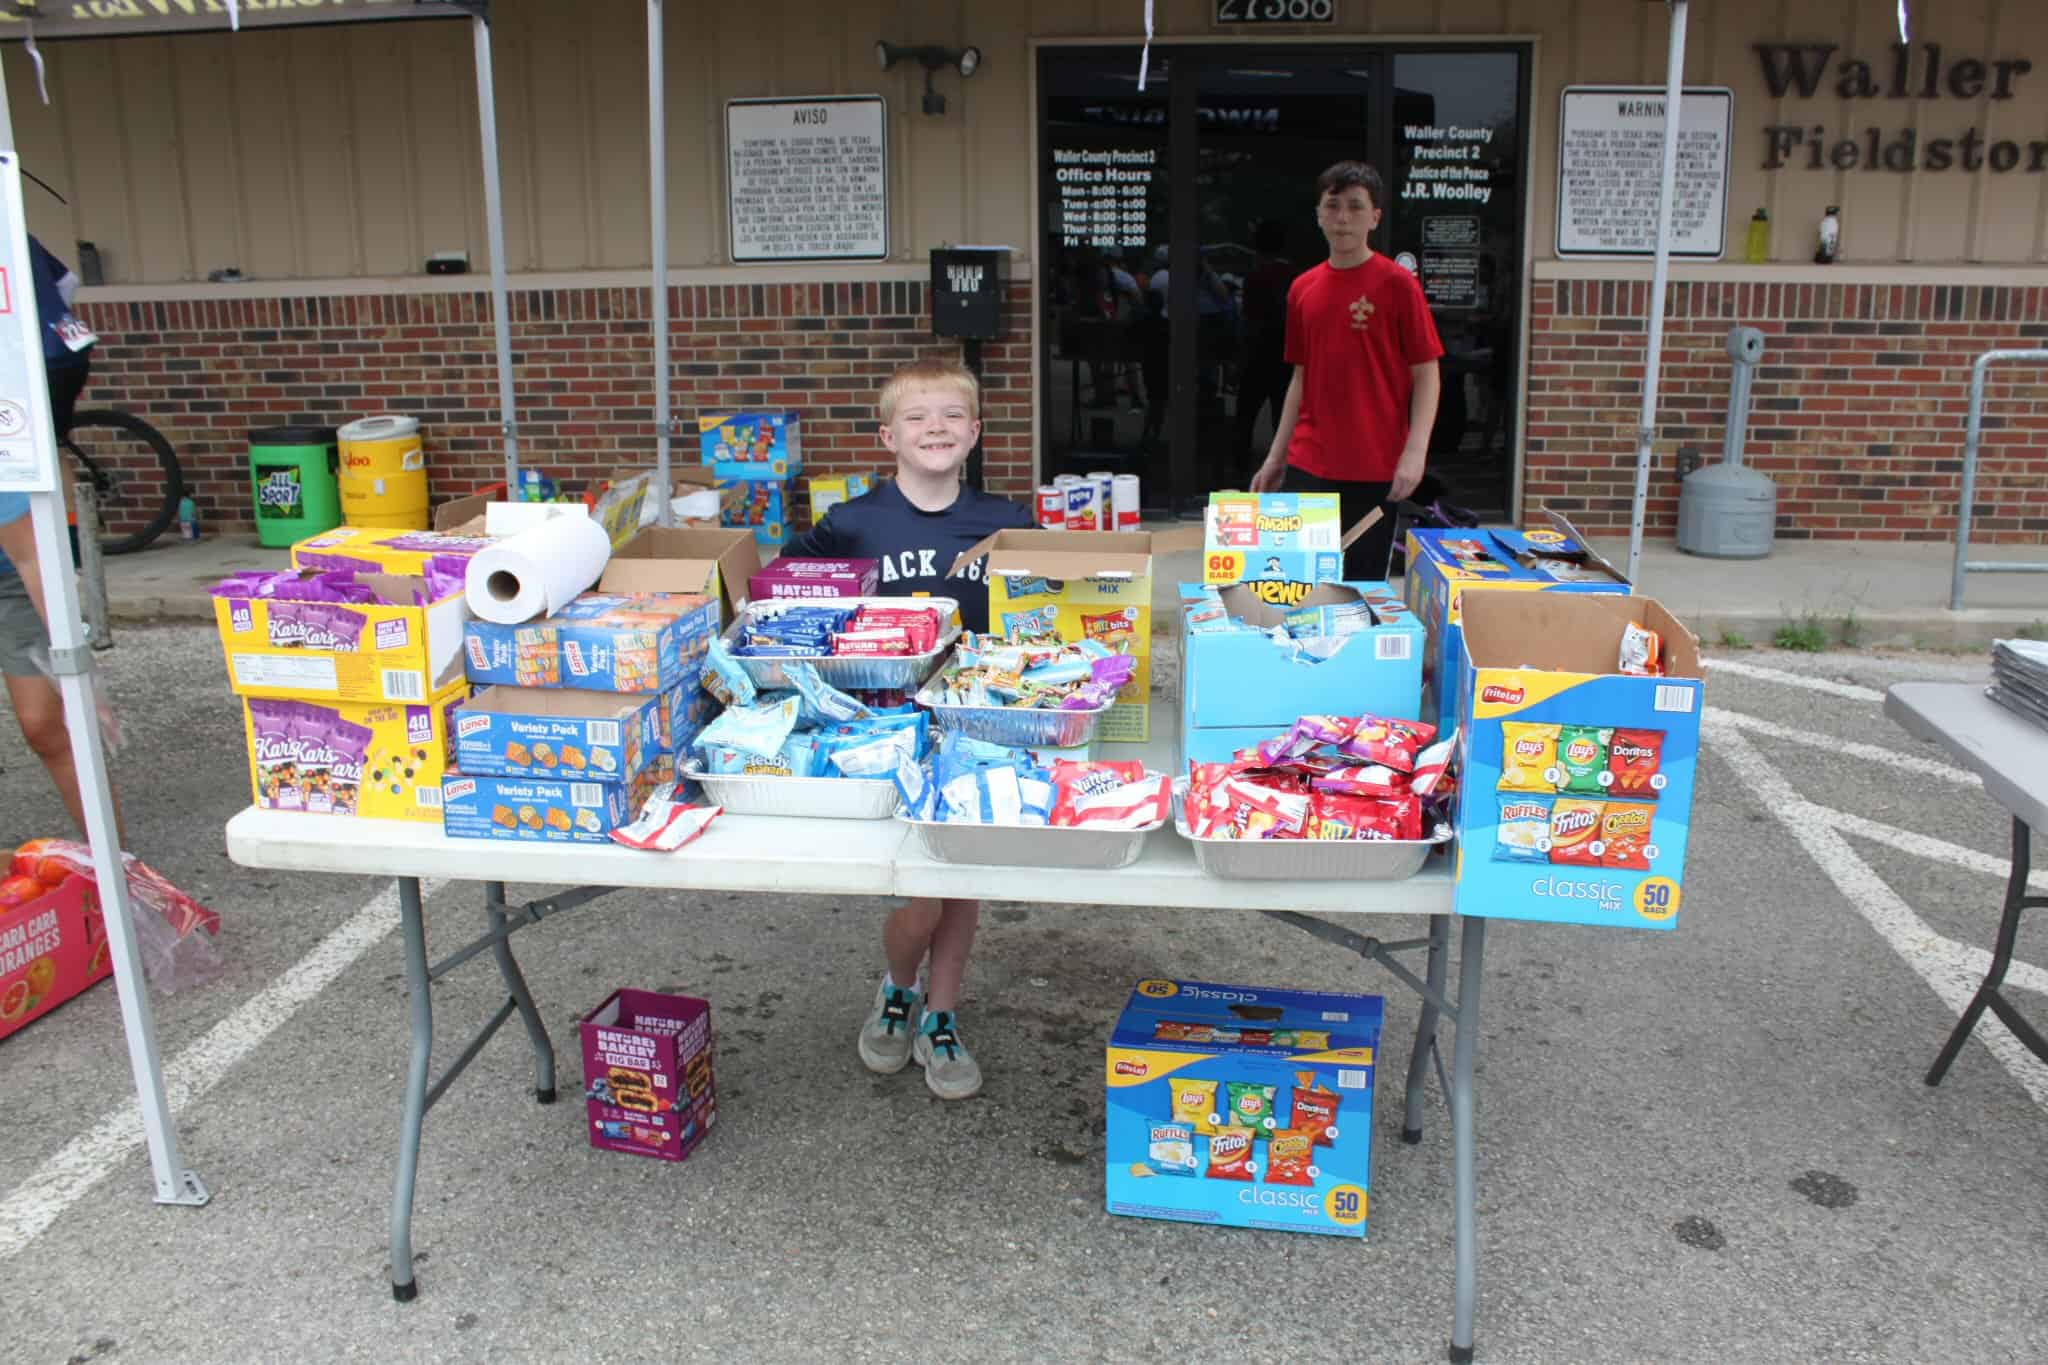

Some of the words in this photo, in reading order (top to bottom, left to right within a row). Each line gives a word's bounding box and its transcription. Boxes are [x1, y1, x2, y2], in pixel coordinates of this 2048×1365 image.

[1752, 41, 2033, 100] Waller
[1617, 101, 1666, 117] WARNIN
[793, 109, 828, 125] AVISO
[1404, 125, 1444, 140] Waller
[1448, 125, 1493, 143] County
[1054, 150, 1081, 163] Waller
[1082, 150, 1111, 165] County
[1112, 149, 1148, 163] Precinct
[1414, 146, 1467, 160] Precinct
[1472, 146, 1480, 160] 2
[1056, 168, 1104, 181] Office
[1105, 168, 1152, 181] Hours
[1409, 165, 1438, 179] Justice
[1463, 166, 1489, 179] Peace
[1062, 185, 1085, 196] Mon
[1401, 182, 1430, 199] J.R.
[1432, 182, 1491, 204] Woolley
[1063, 212, 1087, 222] Wed
[1064, 236, 1079, 247] Fri
[271, 473, 289, 487] ALL
[261, 486, 300, 505] SPORT
[1209, 556, 1235, 570] 60
[1209, 571, 1235, 579] BARS
[1098, 585, 1119, 593] MIX
[232, 609, 250, 621] 40
[409, 714, 429, 731] 40
[459, 716, 489, 732] Lance
[511, 721, 549, 735] Variety
[552, 723, 579, 737] Pack
[1516, 740, 1544, 754] Lay's
[1568, 743, 1596, 758] Lay's
[1613, 745, 1653, 758] Doritos
[445, 781, 475, 796] Lance
[496, 784, 533, 797] Variety
[536, 786, 563, 798] Pack
[1503, 805, 1547, 819] RUFFLES
[1553, 811, 1596, 833] Fritos
[1605, 811, 1648, 830] Cheetos
[1532, 878, 1624, 901] classic
[1643, 884, 1670, 906] 50
[1600, 902, 1623, 911] MIX
[0, 923, 26, 953] ARA
[28, 908, 58, 938] CARA
[598, 1040, 657, 1058] BAKERY
[608, 1055, 626, 1065] FIG
[627, 1057, 648, 1068] BAR
[1152, 1128, 1190, 1141] RUFFLES
[1213, 1136, 1248, 1156] Fritos
[1239, 1185, 1320, 1209] classic
[1334, 1192, 1358, 1211] 50
